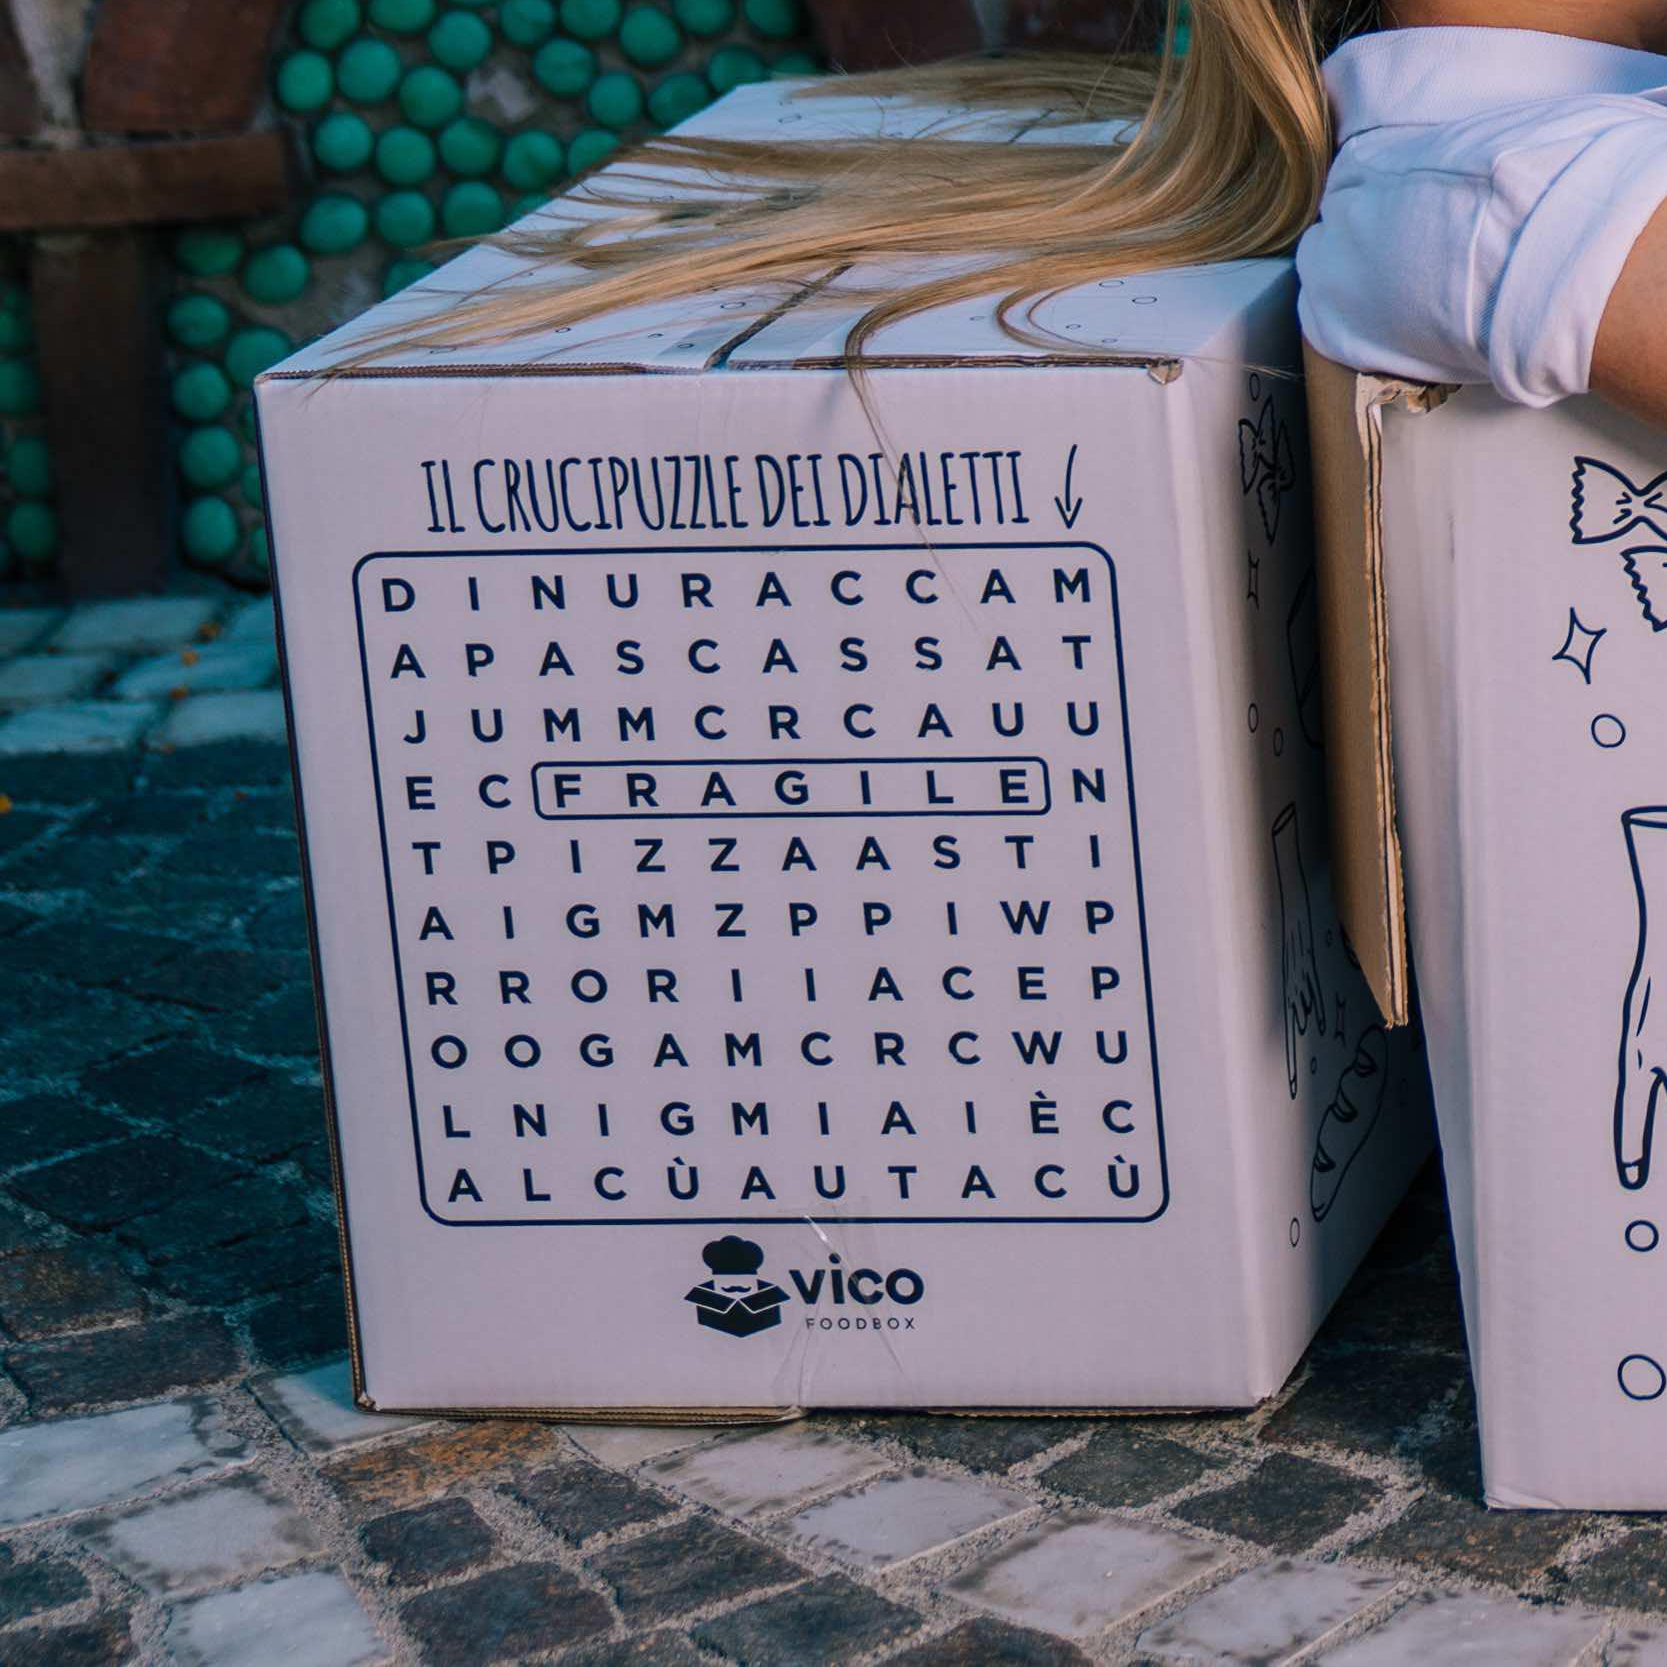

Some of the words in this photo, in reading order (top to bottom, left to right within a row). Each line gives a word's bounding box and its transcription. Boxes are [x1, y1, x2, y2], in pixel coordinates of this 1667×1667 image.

[421, 457, 465, 534] IL
[473, 454, 748, 533] CRUCIPUZZLE
[755, 452, 831, 527] DEI
[839, 449, 1031, 525] DIALETTI
[554, 769, 1029, 808] FRAGILE
[788, 1251, 925, 1305] vico
[805, 1317, 915, 1331] FOODBOX
